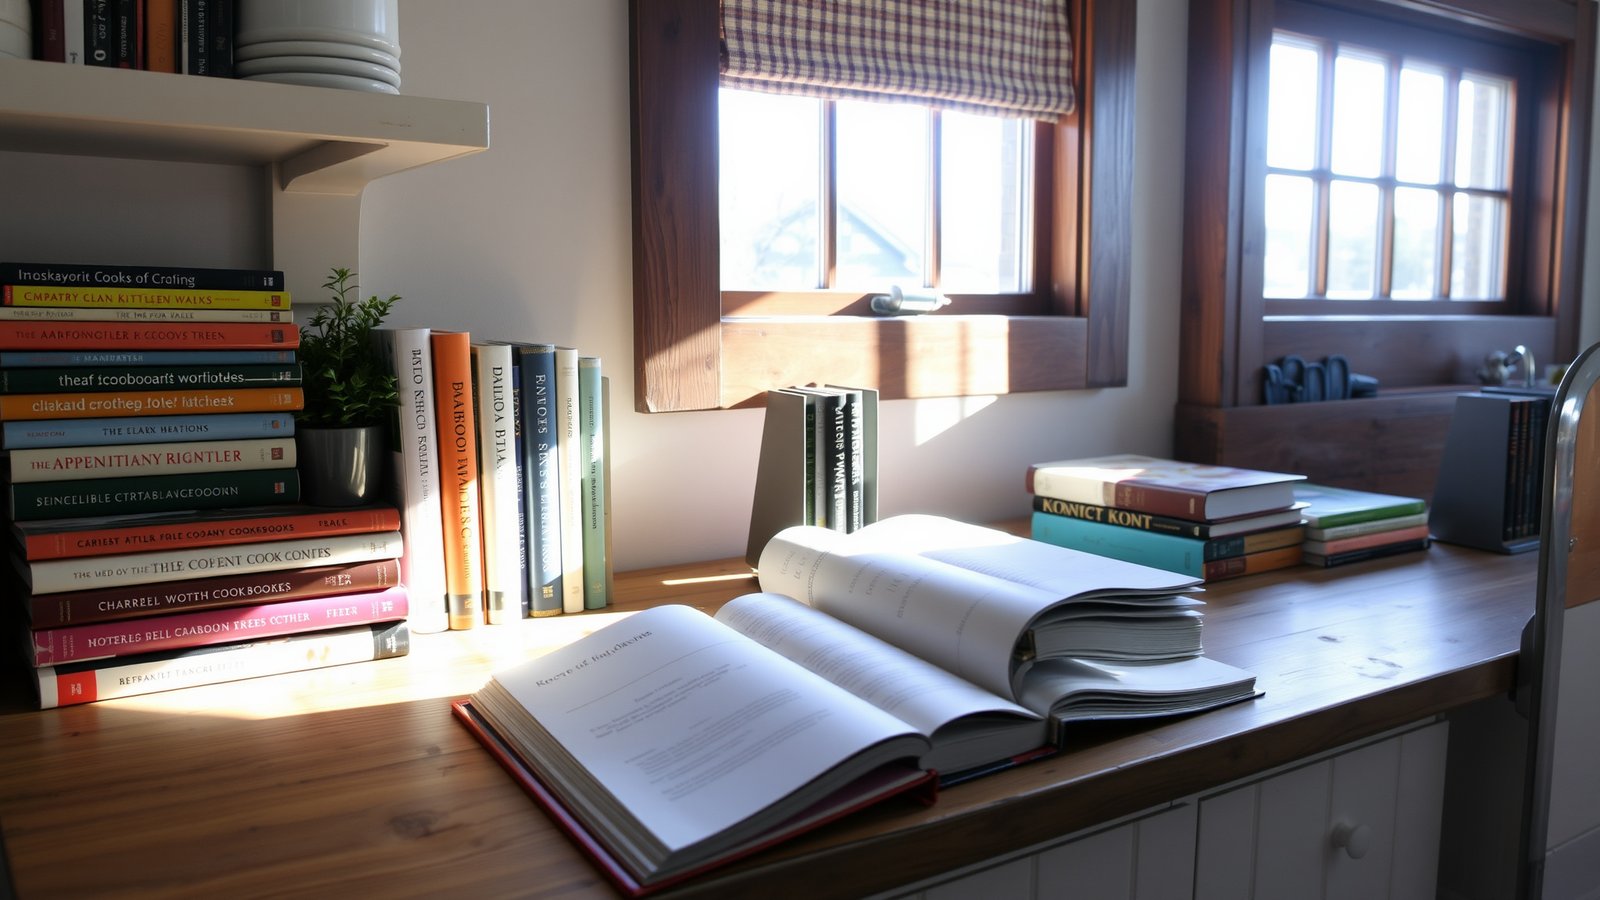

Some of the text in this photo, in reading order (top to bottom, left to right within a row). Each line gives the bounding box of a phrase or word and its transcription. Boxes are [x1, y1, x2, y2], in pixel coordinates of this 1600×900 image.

[94, 271, 132, 284] Cooks
[135, 272, 150, 284] of
[82, 293, 113, 304] CLAN
[102, 427, 122, 437] THE
[31, 460, 51, 471] THE
[1107, 507, 1153, 530] KONT
[247, 550, 283, 565] COOK
[165, 590, 209, 605] WOTTH
